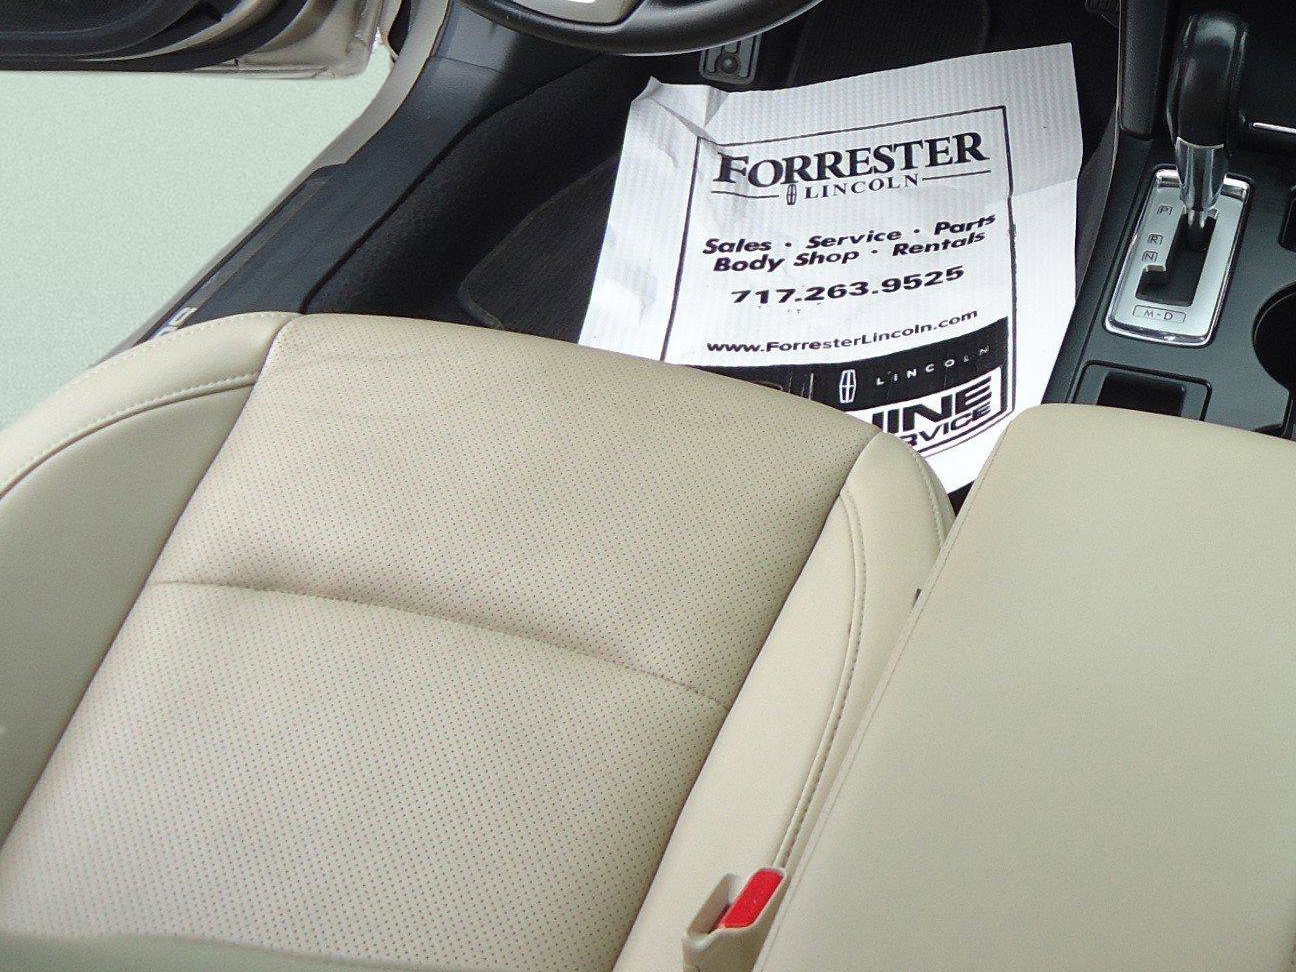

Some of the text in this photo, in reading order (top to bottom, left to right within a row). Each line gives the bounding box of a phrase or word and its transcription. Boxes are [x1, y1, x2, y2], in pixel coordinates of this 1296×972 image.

[713, 131, 990, 188] FORRESTER
[803, 173, 919, 200] LINCOLN
[702, 214, 996, 255] Sales Service Parts
[712, 230, 986, 273] Body Shop Rentals
[731, 265, 965, 305] 717.263.9525
[706, 308, 978, 353] www.ForresterLincoln.com
[876, 344, 992, 385] LINCOLN
[900, 401, 991, 447] RVICE
